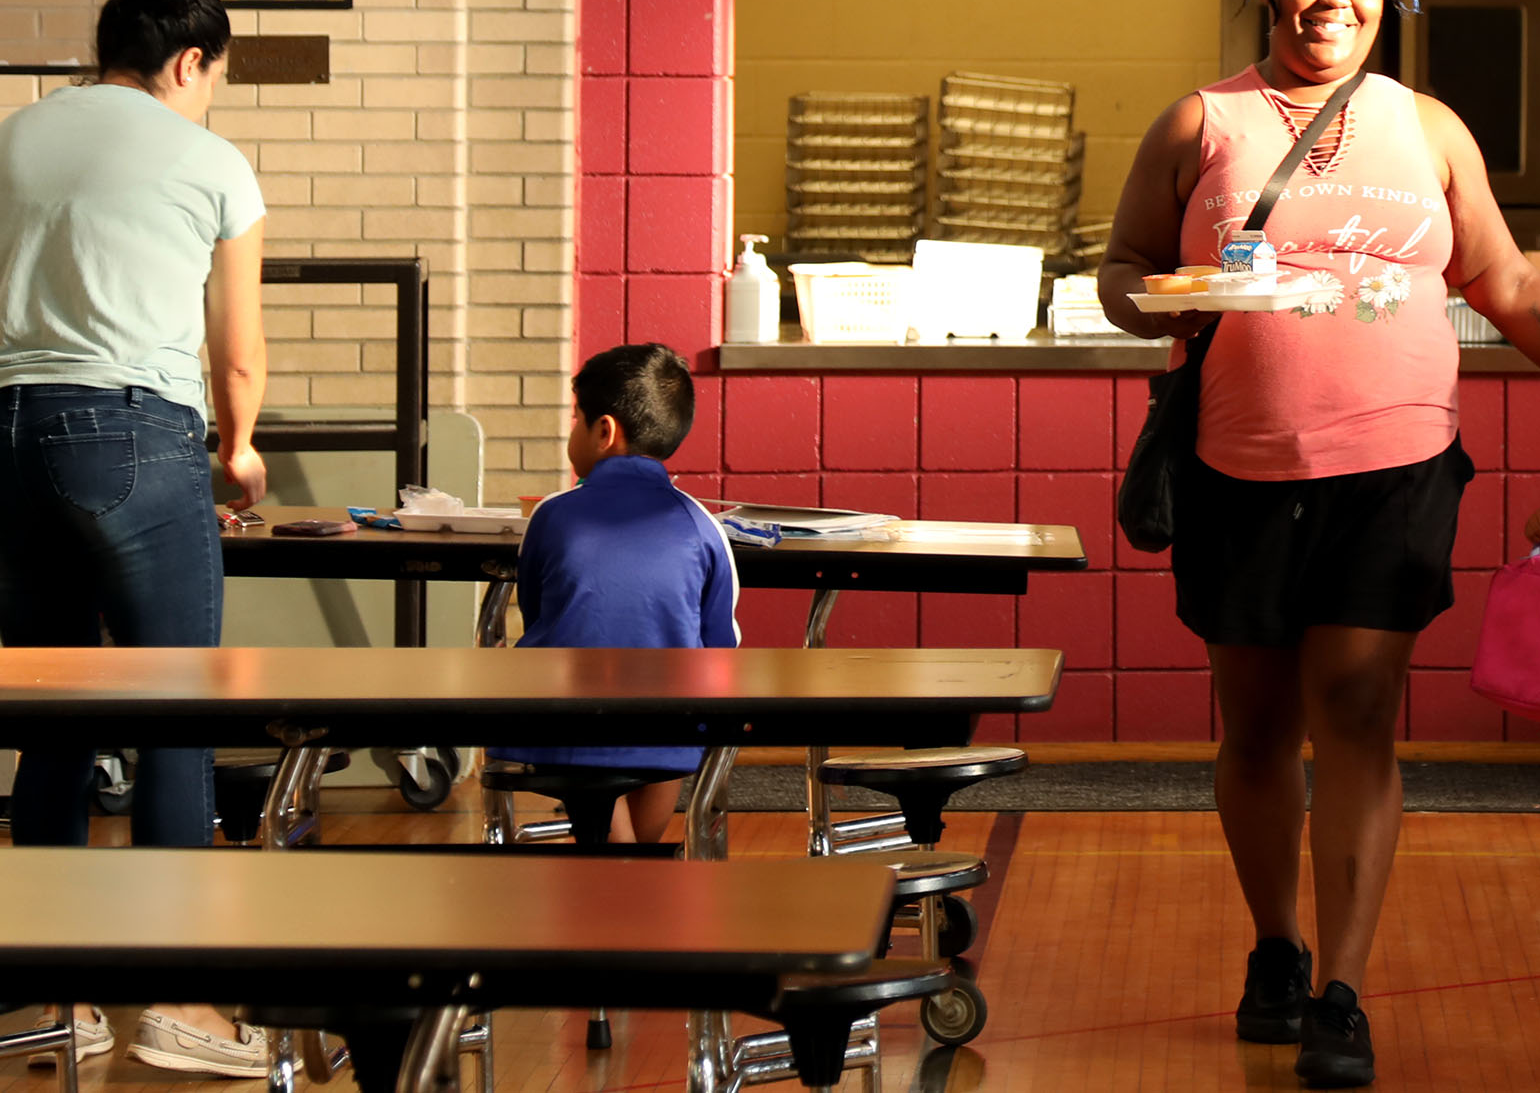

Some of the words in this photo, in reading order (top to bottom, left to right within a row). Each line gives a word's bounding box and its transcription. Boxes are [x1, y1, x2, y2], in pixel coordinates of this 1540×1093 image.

[1204, 194, 1227, 211] BE
[1232, 188, 1292, 204] YOR
[1299, 183, 1353, 198] OWN
[1362, 185, 1417, 205] KIND
[1210, 214, 1432, 275] Bautiful
